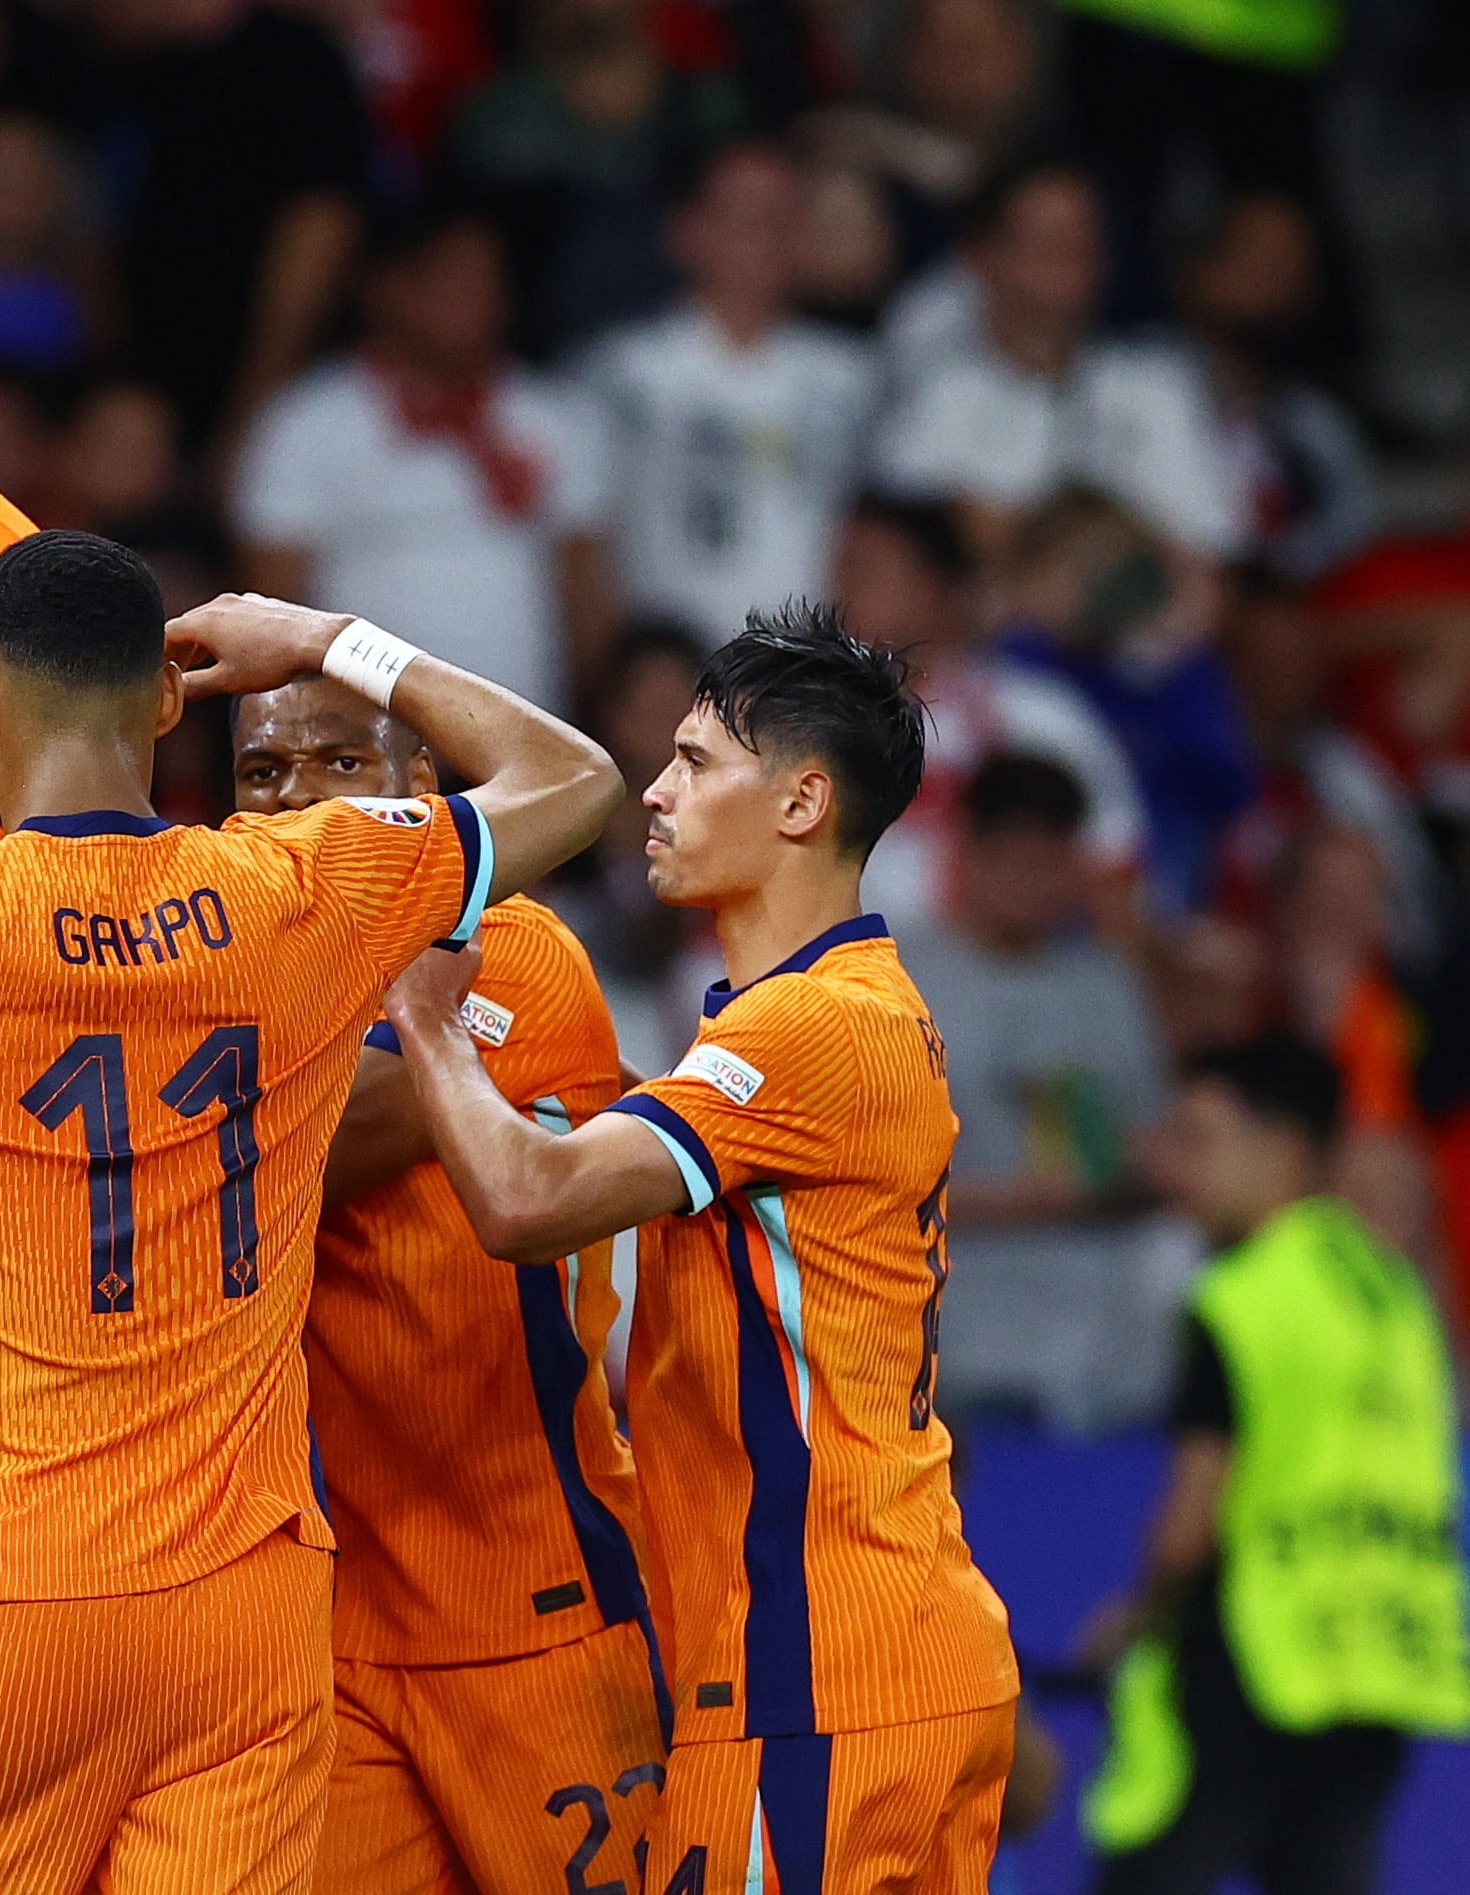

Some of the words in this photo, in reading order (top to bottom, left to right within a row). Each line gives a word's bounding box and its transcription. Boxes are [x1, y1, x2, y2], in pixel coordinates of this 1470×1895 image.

[54, 888, 232, 966] GAKPO
[460, 1003, 507, 1034] ATION
[707, 1059, 756, 1095] ATION
[19, 1025, 262, 1314] 11
[909, 1160, 950, 1430] 1
